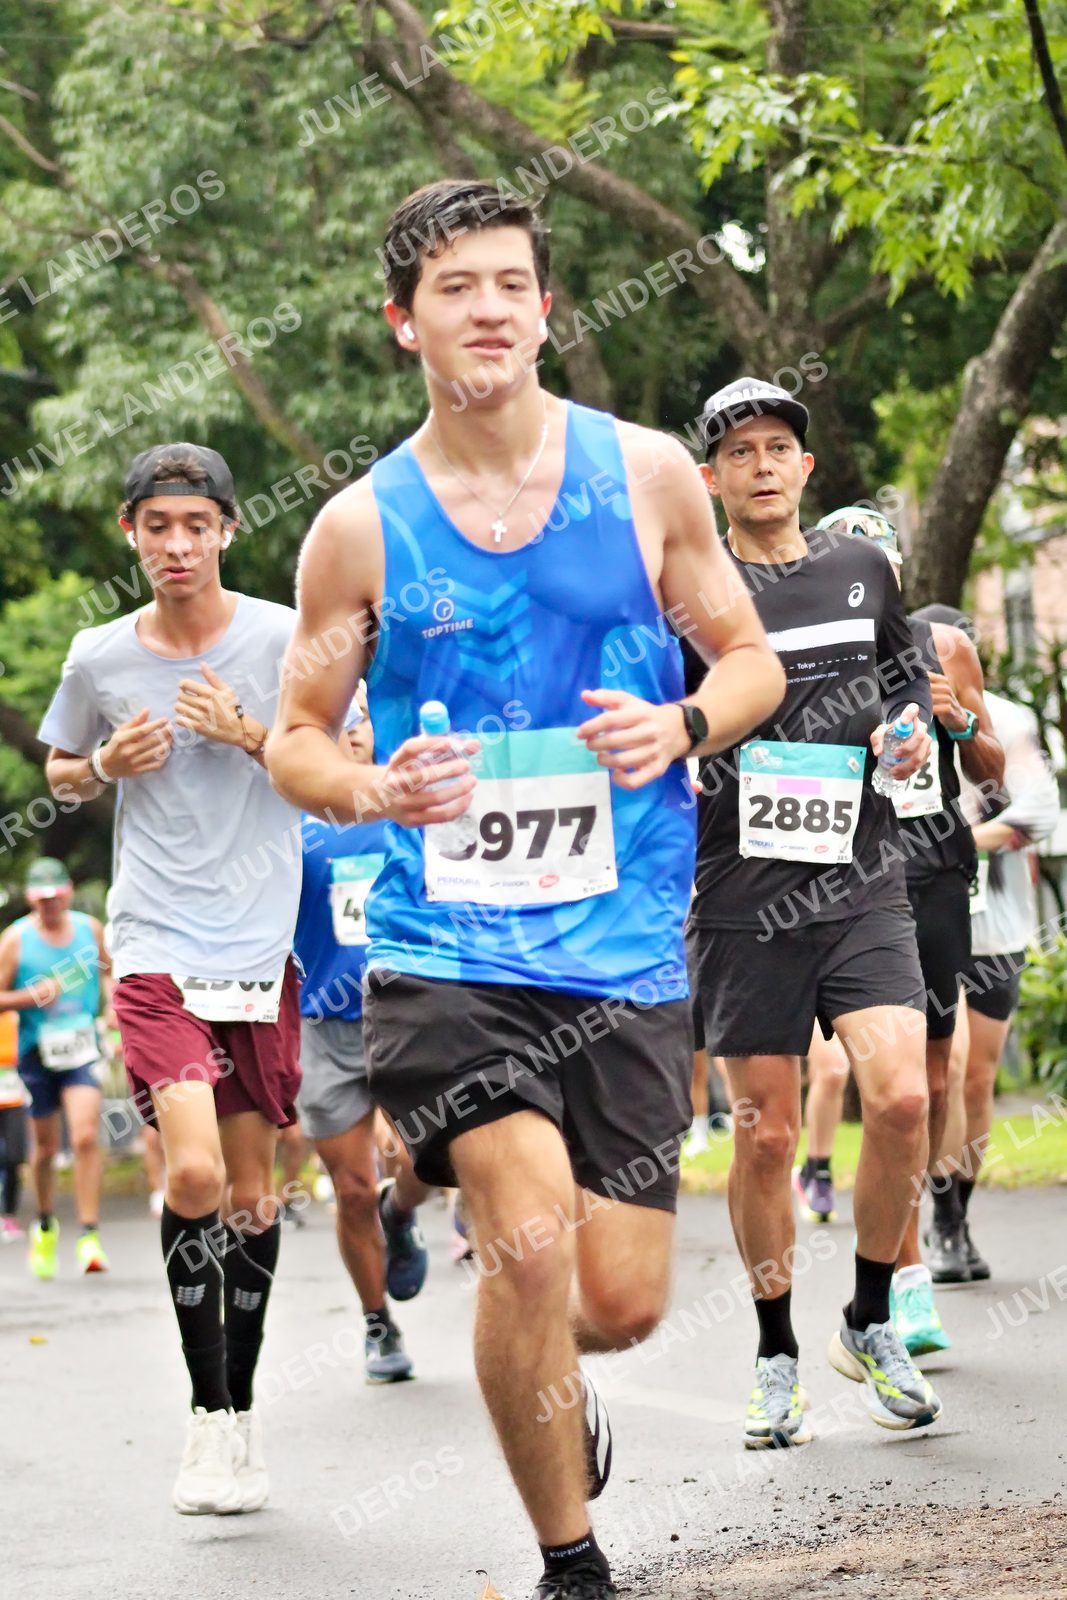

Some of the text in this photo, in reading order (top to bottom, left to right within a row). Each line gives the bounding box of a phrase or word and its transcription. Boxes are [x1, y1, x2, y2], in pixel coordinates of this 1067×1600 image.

[422, 618, 474, 639] TOPTIME
[796, 662, 816, 670] Tokyo
[748, 795, 853, 835] 2885
[438, 805, 597, 862] 977
[549, 1540, 590, 1558] KIPRUN
